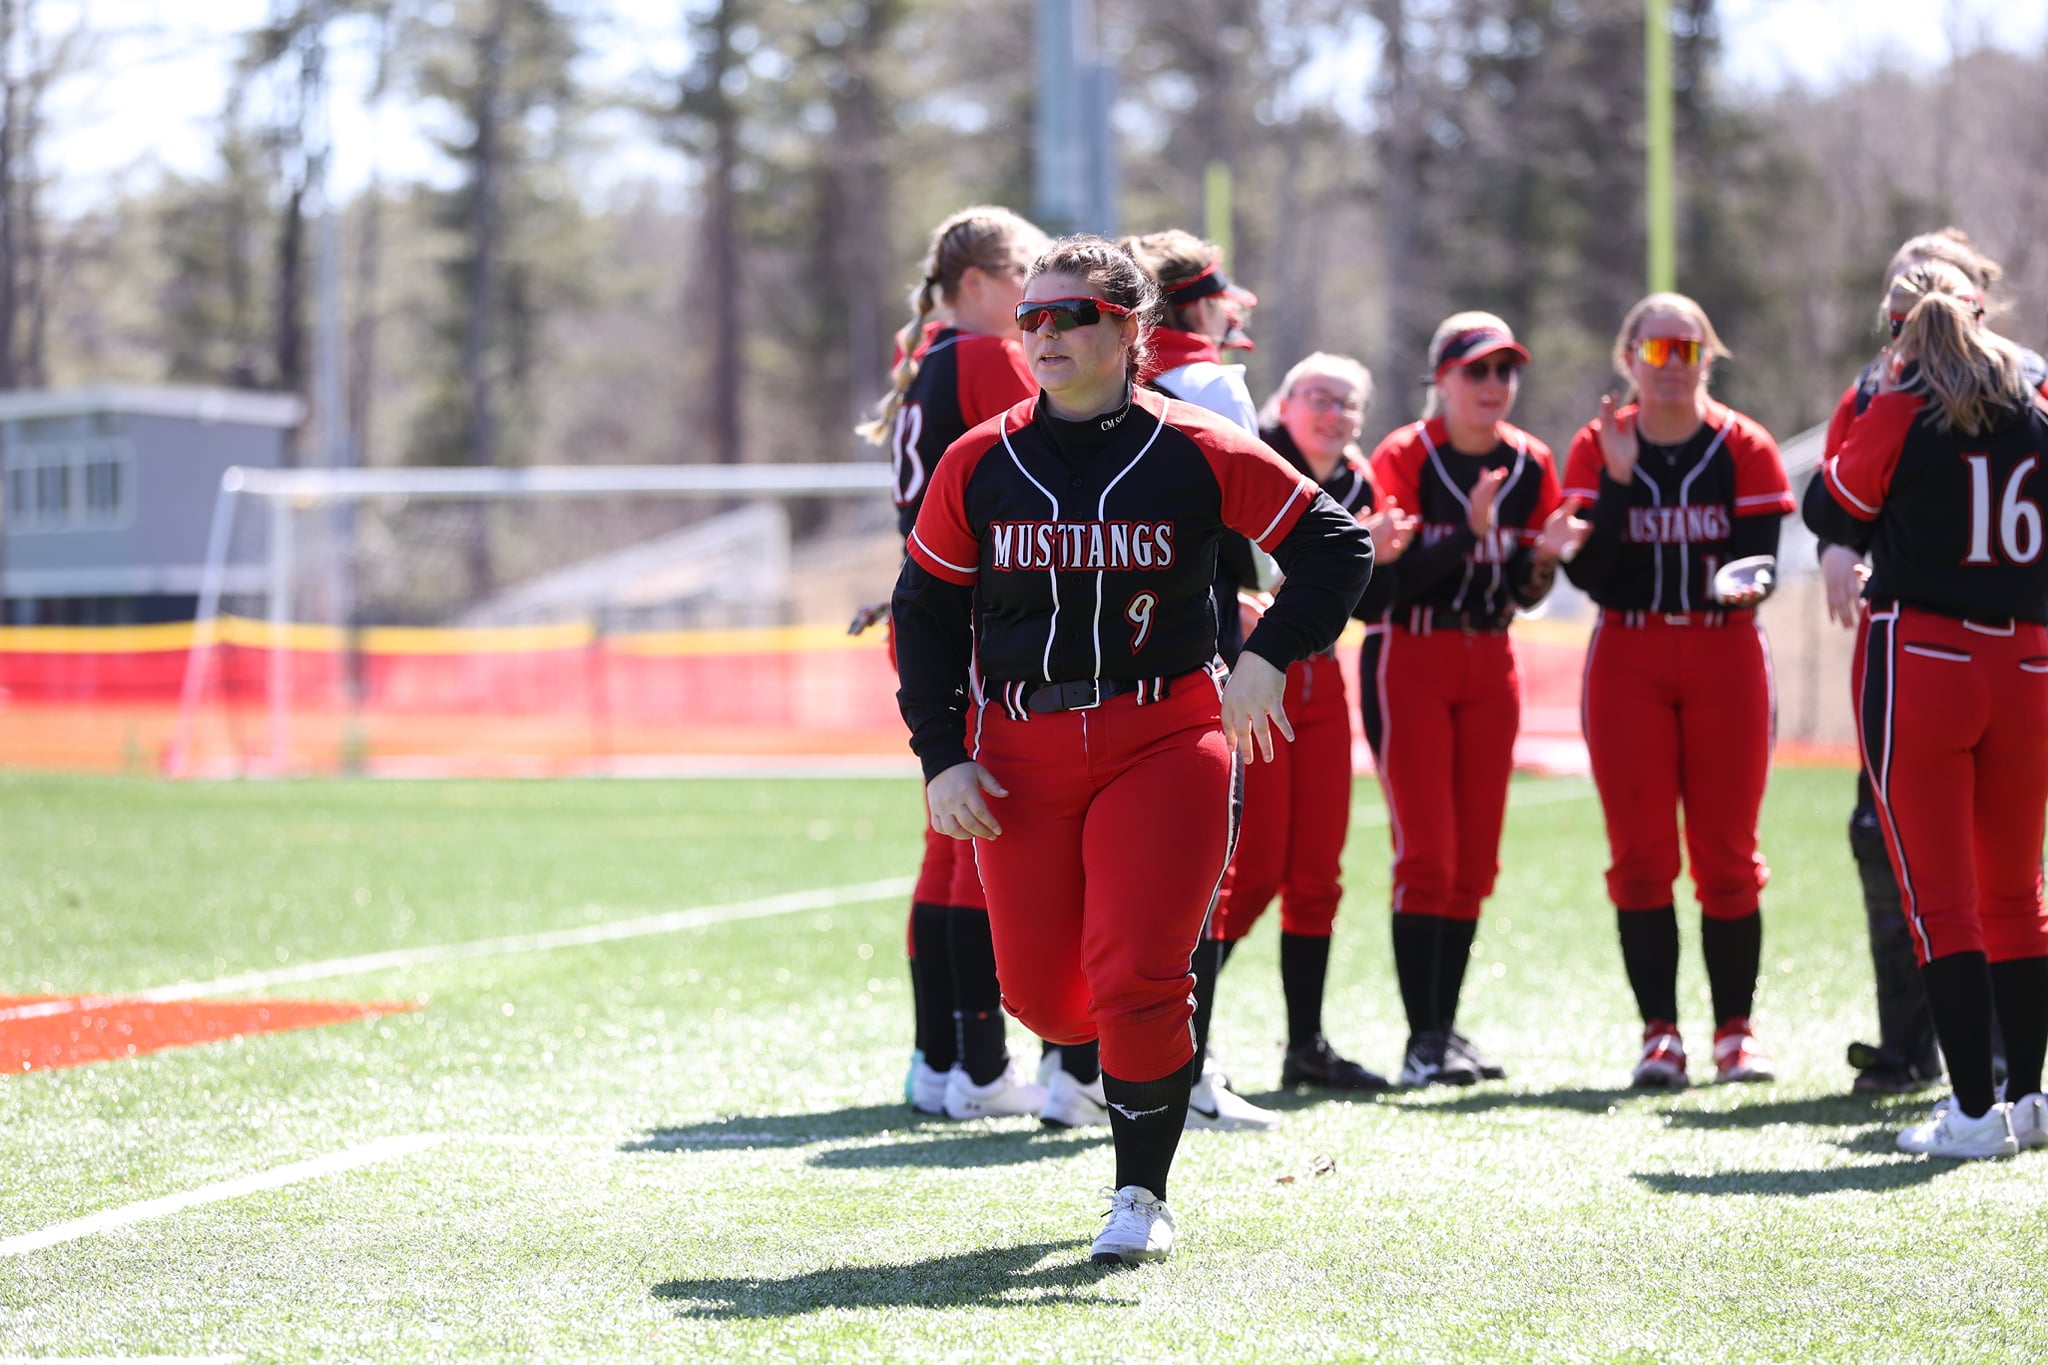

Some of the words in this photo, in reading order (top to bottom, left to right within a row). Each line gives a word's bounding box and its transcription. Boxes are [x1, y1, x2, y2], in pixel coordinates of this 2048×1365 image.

[1626, 504, 1732, 543] USTANGS
[1961, 452, 2044, 566] 16
[1124, 590, 1158, 653] 9
